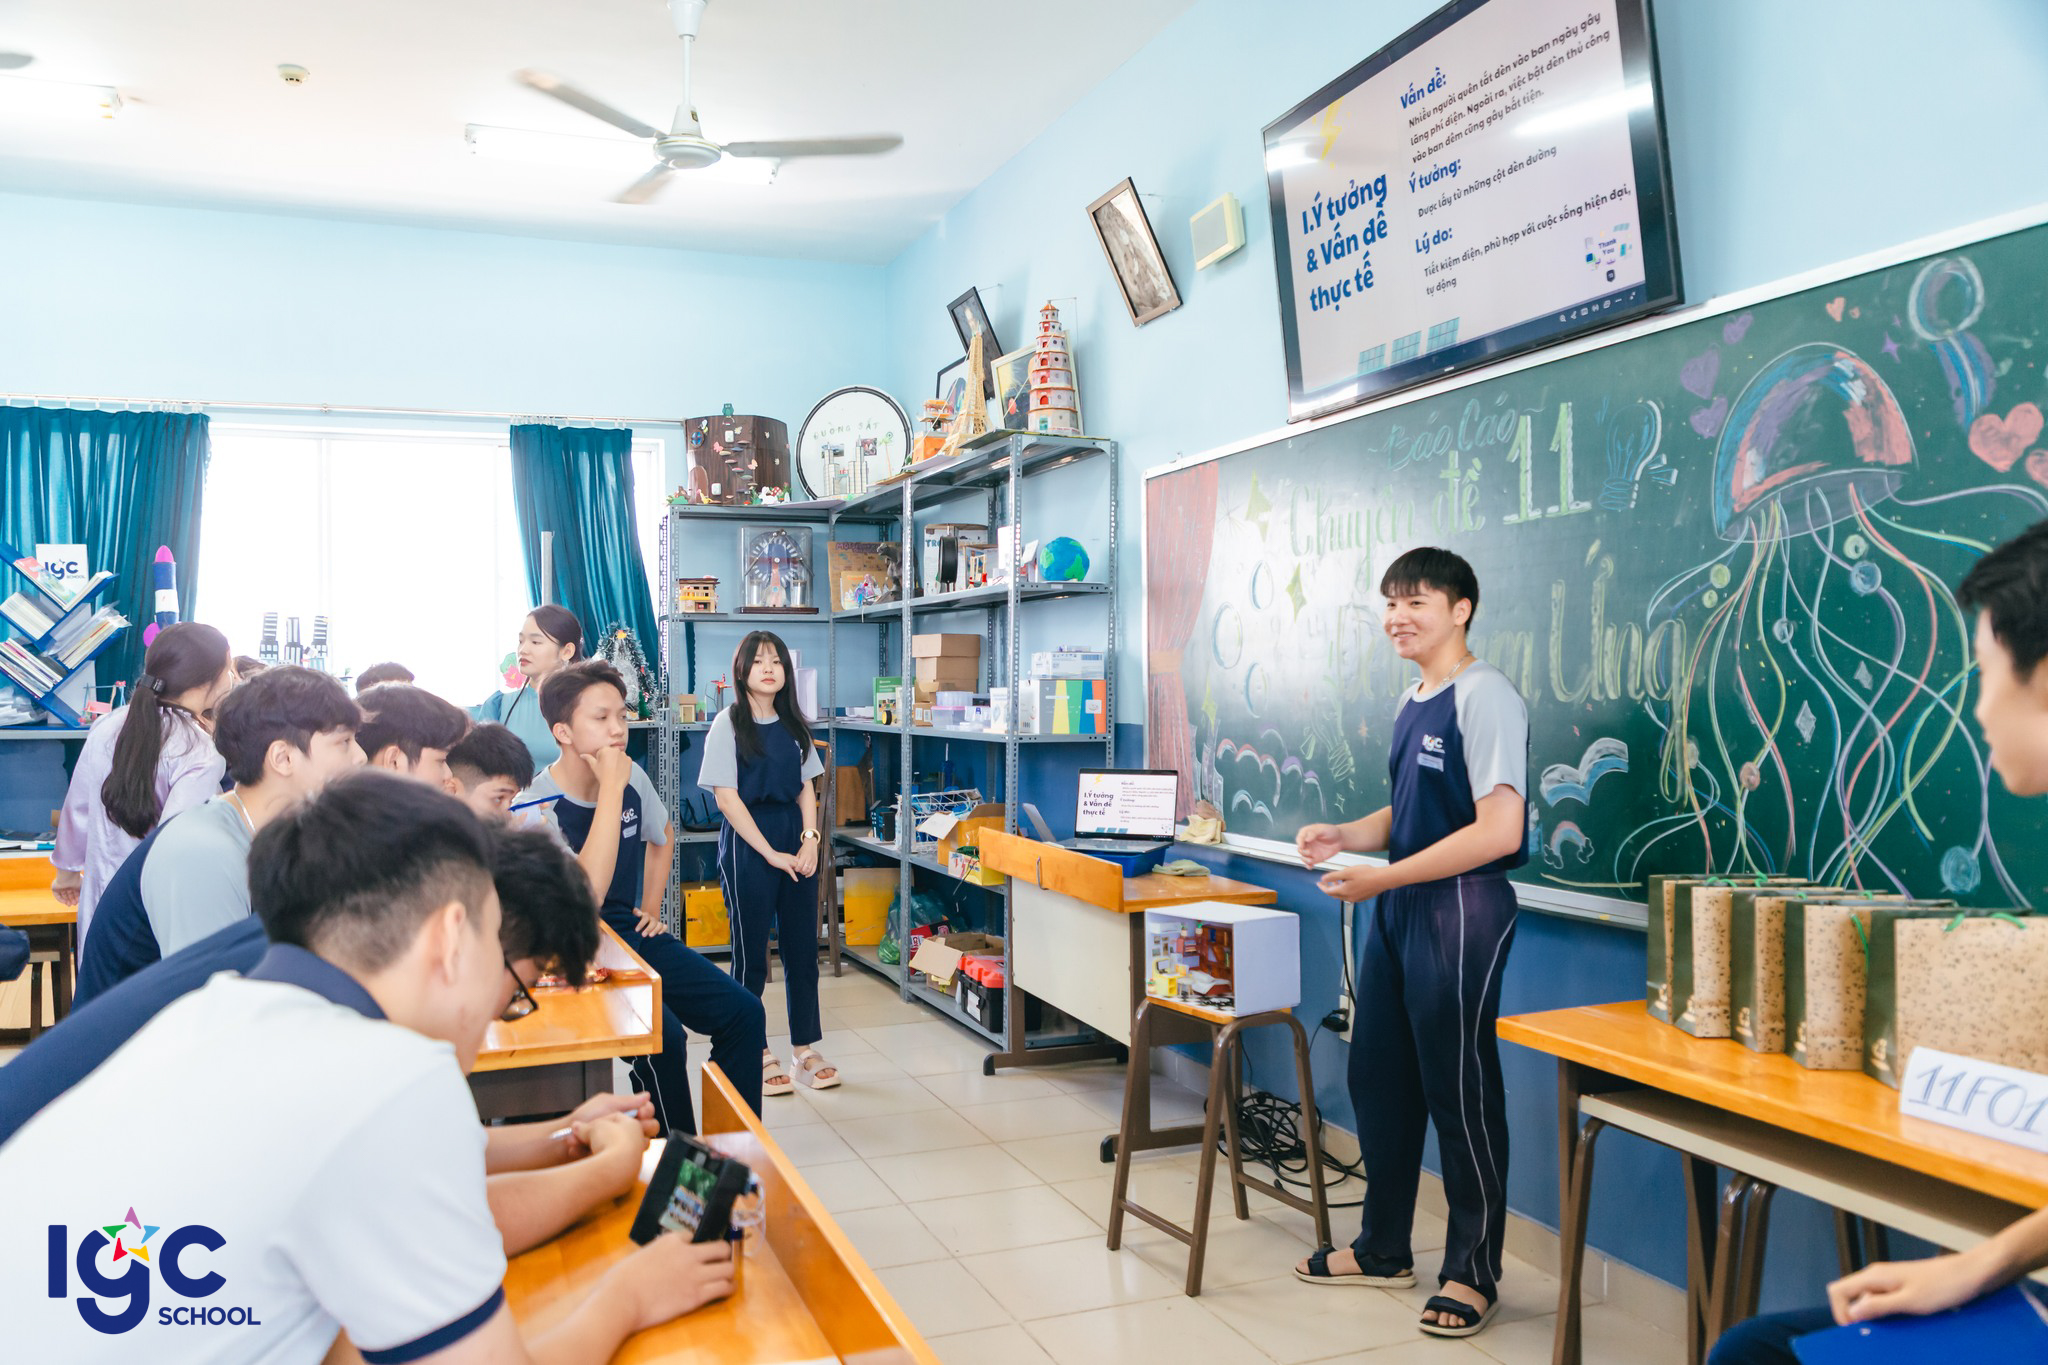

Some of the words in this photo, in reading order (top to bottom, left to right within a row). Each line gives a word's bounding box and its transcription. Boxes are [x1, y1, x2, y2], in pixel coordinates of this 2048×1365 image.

[1400, 82, 1425, 109] Vấn
[1427, 66, 1446, 94] đề:
[1409, 107, 1432, 128] Nhiều
[1432, 93, 1456, 114] người
[1457, 83, 1479, 101] quên
[1480, 70, 1493, 87] tắt
[1494, 64, 1511, 79] đèn
[1512, 53, 1530, 68] vào
[1531, 42, 1550, 58] ban
[1552, 26, 1578, 45] ngày
[1580, 13, 1600, 32] gây
[1430, 119, 1444, 137] phí
[1445, 112, 1466, 126] điện.
[1467, 91, 1493, 113] Ngoài
[1495, 88, 1508, 100] ra,
[1508, 75, 1526, 91] việc
[1527, 65, 1544, 81] bật
[1546, 55, 1565, 71] đèn
[1566, 40, 1583, 60] thủ
[1585, 33, 1610, 50] công
[1412, 150, 1427, 163] vào
[1428, 141, 1444, 155] ban
[1445, 131, 1463, 146] đêm
[1464, 119, 1485, 137] cũng
[1486, 109, 1503, 126] gây
[1505, 96, 1521, 114] bất
[1522, 88, 1544, 104] tiện.
[1302, 191, 1323, 235] I.Ý
[1326, 173, 1388, 221] tưởng
[1409, 171, 1417, 193] Ý
[1419, 158, 1461, 189] tưởng:
[1418, 202, 1438, 218] Được
[1438, 192, 1452, 209] lấy
[1453, 188, 1462, 201] từ
[1463, 177, 1491, 197] những
[1492, 169, 1506, 183] cột
[1507, 160, 1525, 175] đèn
[1526, 146, 1557, 166] đường
[1307, 249, 1319, 273] &
[1320, 221, 1359, 266] Vấn
[1362, 202, 1388, 246] đề
[1415, 231, 1430, 254] Lý
[1432, 227, 1453, 246] do:
[1424, 261, 1439, 278] Tiết
[1440, 256, 1461, 271] kiệm
[1462, 246, 1484, 262] điện,
[1484, 236, 1501, 254] phù
[1502, 229, 1520, 246] hợp
[1521, 222, 1536, 237] với
[1537, 214, 1558, 230] cuộc
[1559, 203, 1583, 218] sống
[1584, 194, 1608, 210] hiện
[1609, 183, 1631, 201] đại,
[1598, 238, 1617, 249] Thank
[1310, 277, 1352, 312] thực
[1354, 250, 1374, 293] tế
[1426, 285, 1435, 297] tự
[1436, 277, 1458, 293] động
[1387, 409, 1452, 472] Báo
[1457, 391, 1516, 451] Cáo
[1289, 481, 1417, 593] Chuyên
[1432, 450, 1486, 538] đề
[1503, 401, 1593, 526] 11
